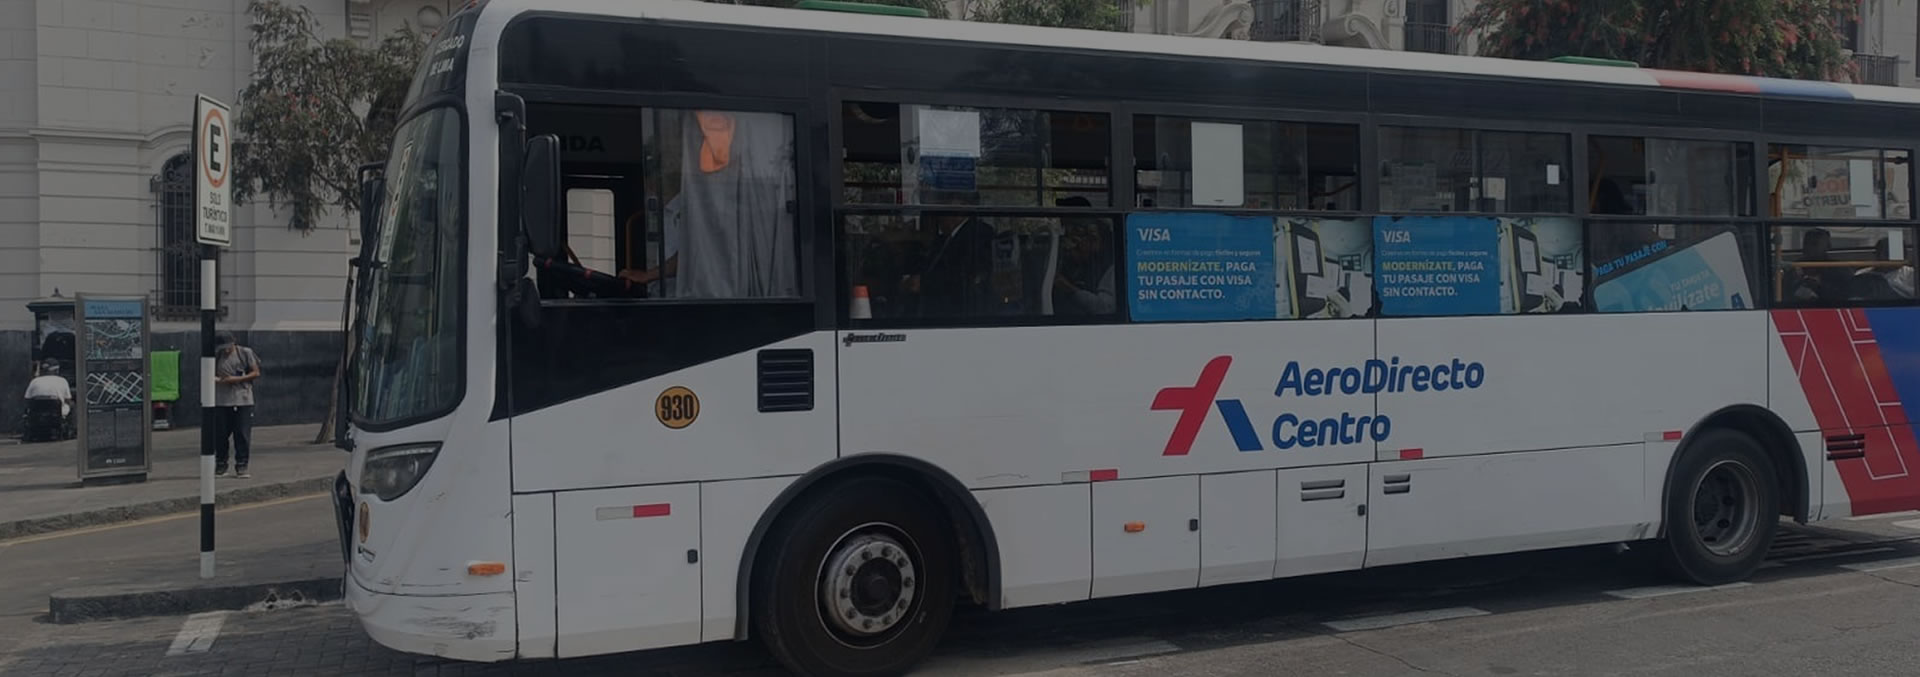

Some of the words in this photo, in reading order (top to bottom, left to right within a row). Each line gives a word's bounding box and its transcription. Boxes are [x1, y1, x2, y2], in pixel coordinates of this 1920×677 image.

[210, 123, 221, 172] E
[560, 134, 606, 153] IDA
[1136, 228, 1171, 241] VISA
[1382, 230, 1411, 243] VISA
[1137, 259, 1225, 273] MODERNÍZATE,
[1226, 261, 1256, 272] PAGA
[1382, 259, 1456, 272] MODERNÍZATE,
[1458, 261, 1484, 271] PAGA
[1137, 275, 1154, 286] TU
[1156, 275, 1198, 286] PASAJE
[1200, 275, 1224, 286] CON
[1226, 275, 1253, 286] VISA
[1382, 274, 1397, 284] TU
[1398, 274, 1434, 284] PASAJE
[1436, 273, 1458, 284] CON
[1459, 273, 1480, 284] VISA
[1138, 289, 1158, 300] SIN
[1160, 288, 1225, 300] CONTACTO.
[1383, 287, 1400, 297] SIN
[1401, 286, 1458, 297] CONTACTO.
[1275, 356, 1484, 398] AeroDirecto
[661, 394, 694, 421] 930
[1272, 412, 1391, 450] Centro
